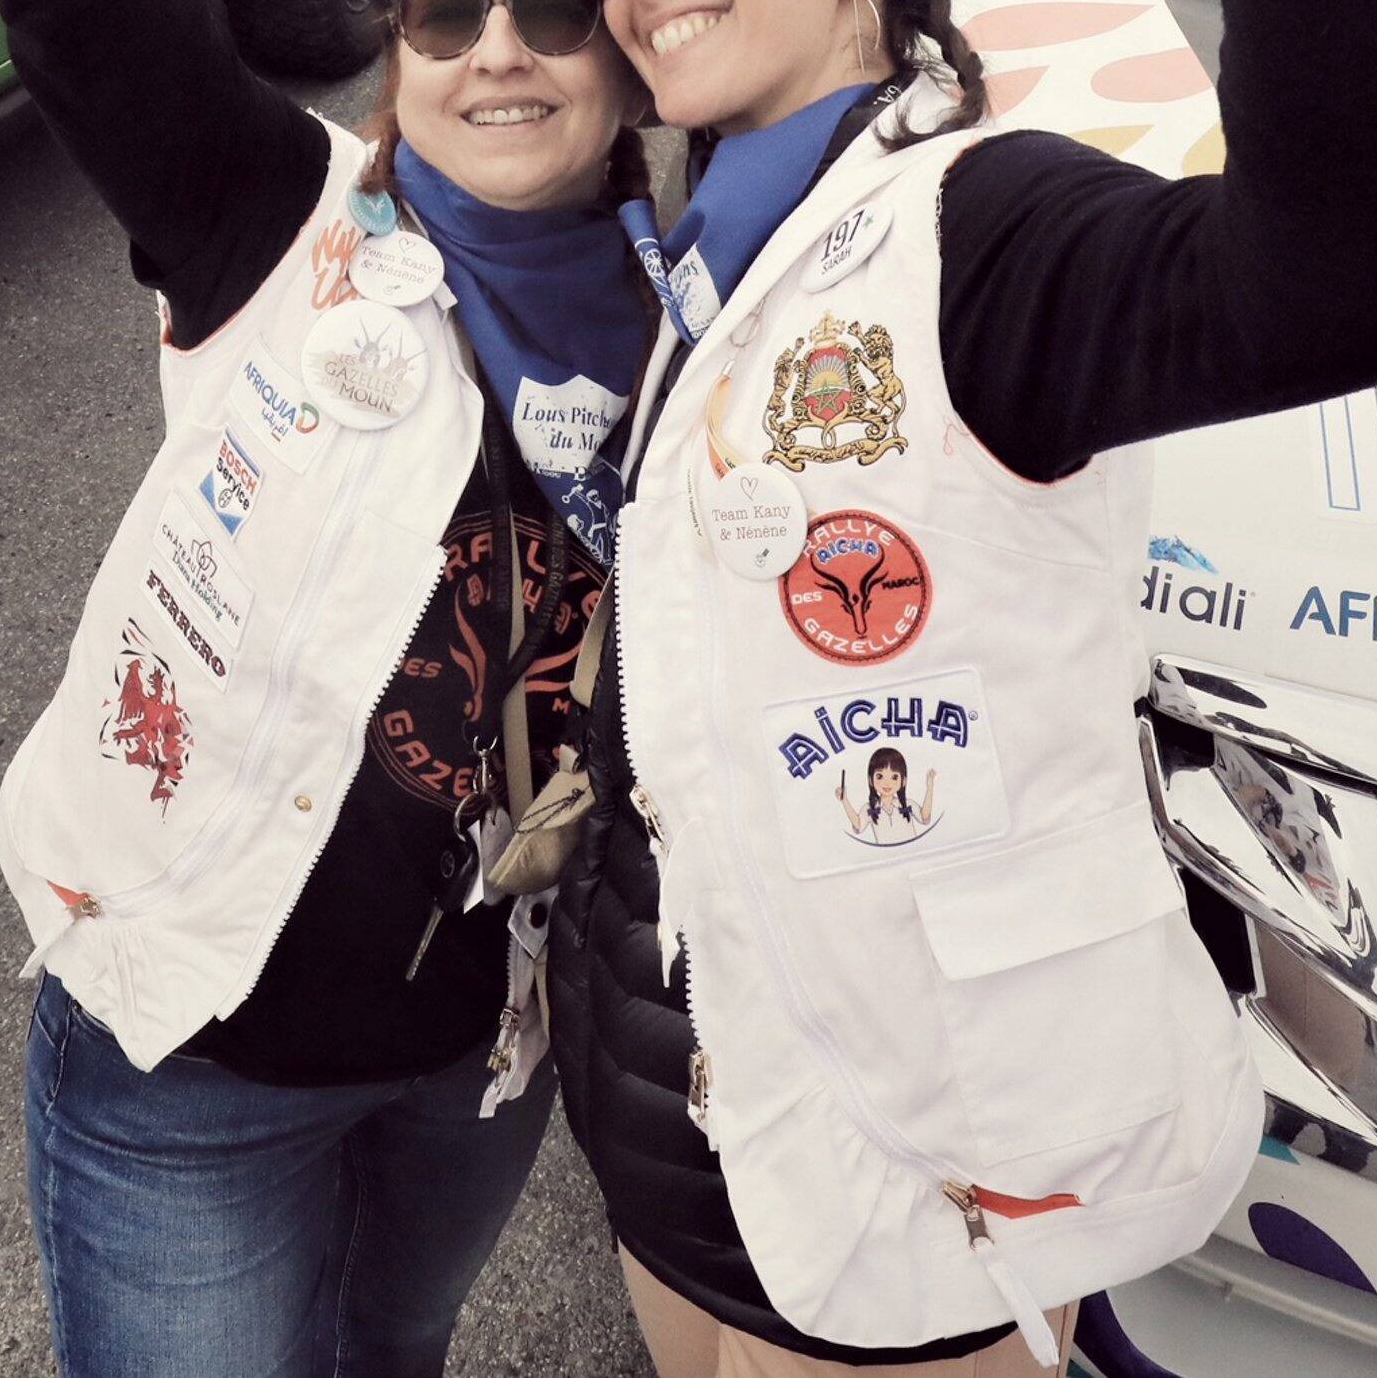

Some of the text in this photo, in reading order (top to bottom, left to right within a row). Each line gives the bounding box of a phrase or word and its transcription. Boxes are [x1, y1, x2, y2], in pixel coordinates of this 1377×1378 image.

[819, 209, 866, 262] 197
[821, 244, 854, 275] SARAH
[244, 359, 296, 429] AFRIQUIA
[324, 361, 399, 398] GAZELLES
[339, 383, 394, 412] MOUN
[521, 401, 566, 422] Lous
[549, 429, 573, 449] du
[214, 457, 251, 512] Service
[219, 440, 258, 496] BOSCH
[711, 505, 791, 523] Team Kany
[718, 524, 788, 542] & Nénène
[804, 519, 896, 558] RALLYE
[199, 573, 241, 627] ROSLANE
[791, 591, 824, 605] DES
[880, 576, 921, 591] MAROC
[145, 570, 227, 679] FERRERO
[804, 603, 920, 654] GAZELLES
